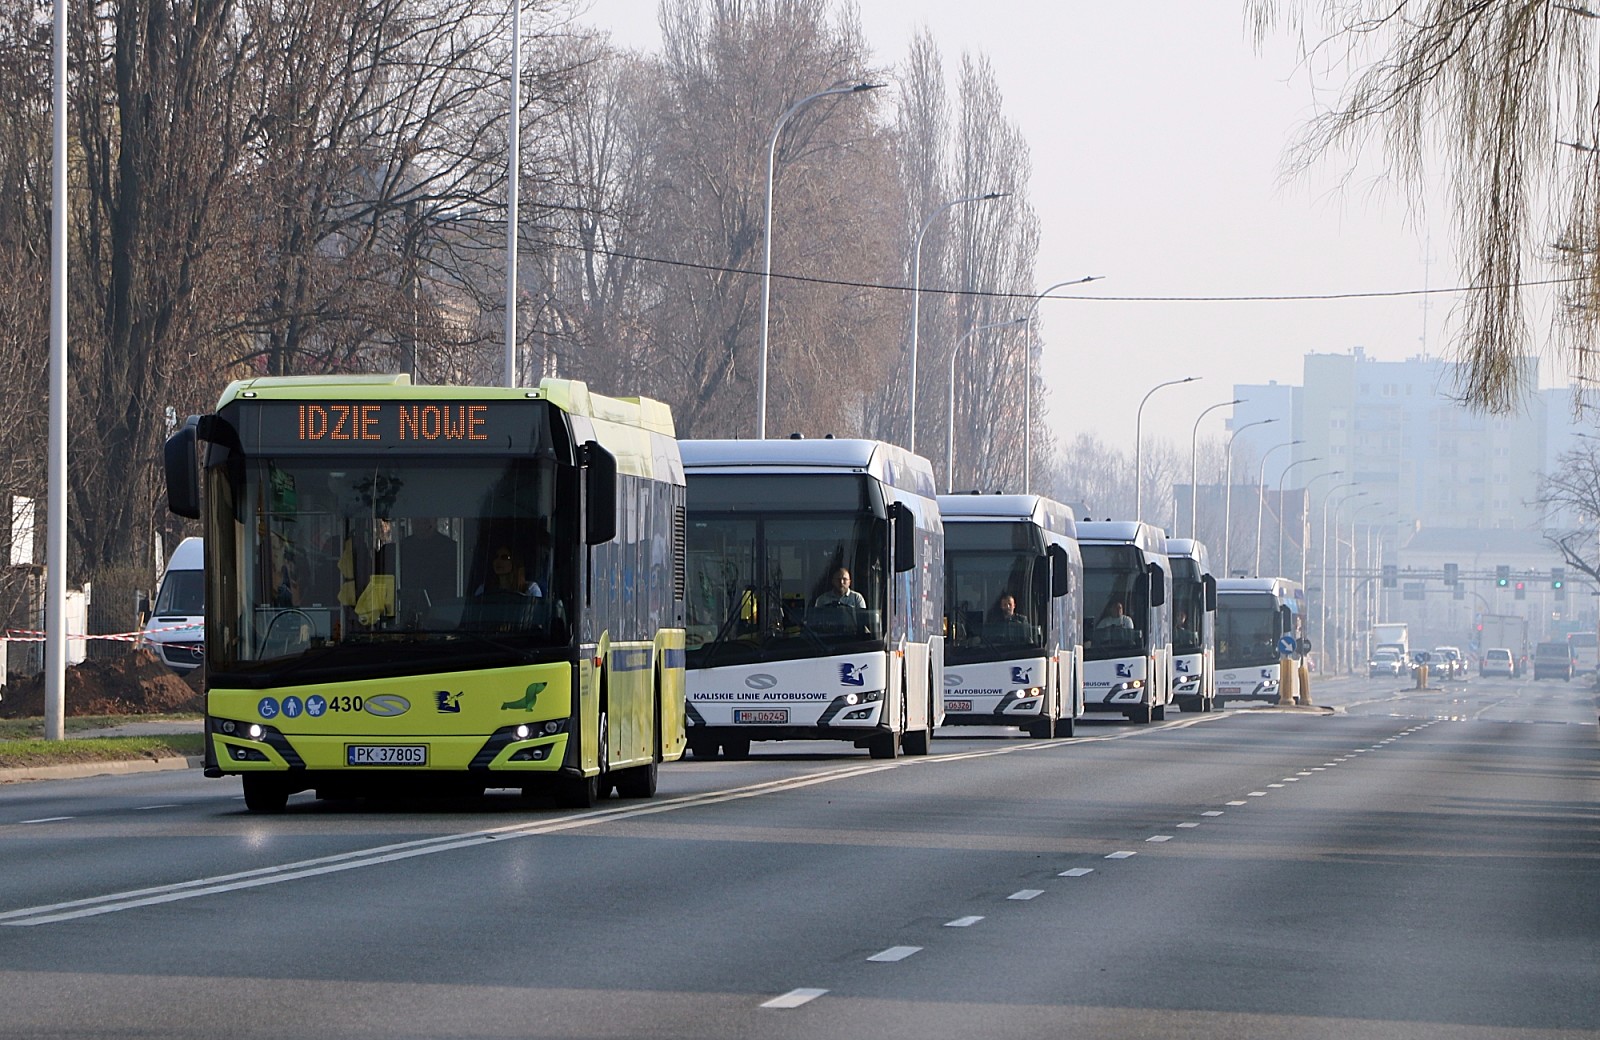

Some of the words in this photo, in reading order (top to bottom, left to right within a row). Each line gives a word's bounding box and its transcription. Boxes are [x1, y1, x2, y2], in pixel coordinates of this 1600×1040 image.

[299, 405, 381, 440] IDZIE
[399, 405, 488, 440] NOWE
[329, 695, 363, 712] 430
[693, 692, 734, 700] KALISKIE
[737, 692, 760, 700] LINIE
[763, 692, 827, 700] AUTOBUSOWE
[357, 748, 375, 761] PK
[380, 748, 422, 761] 3780S
